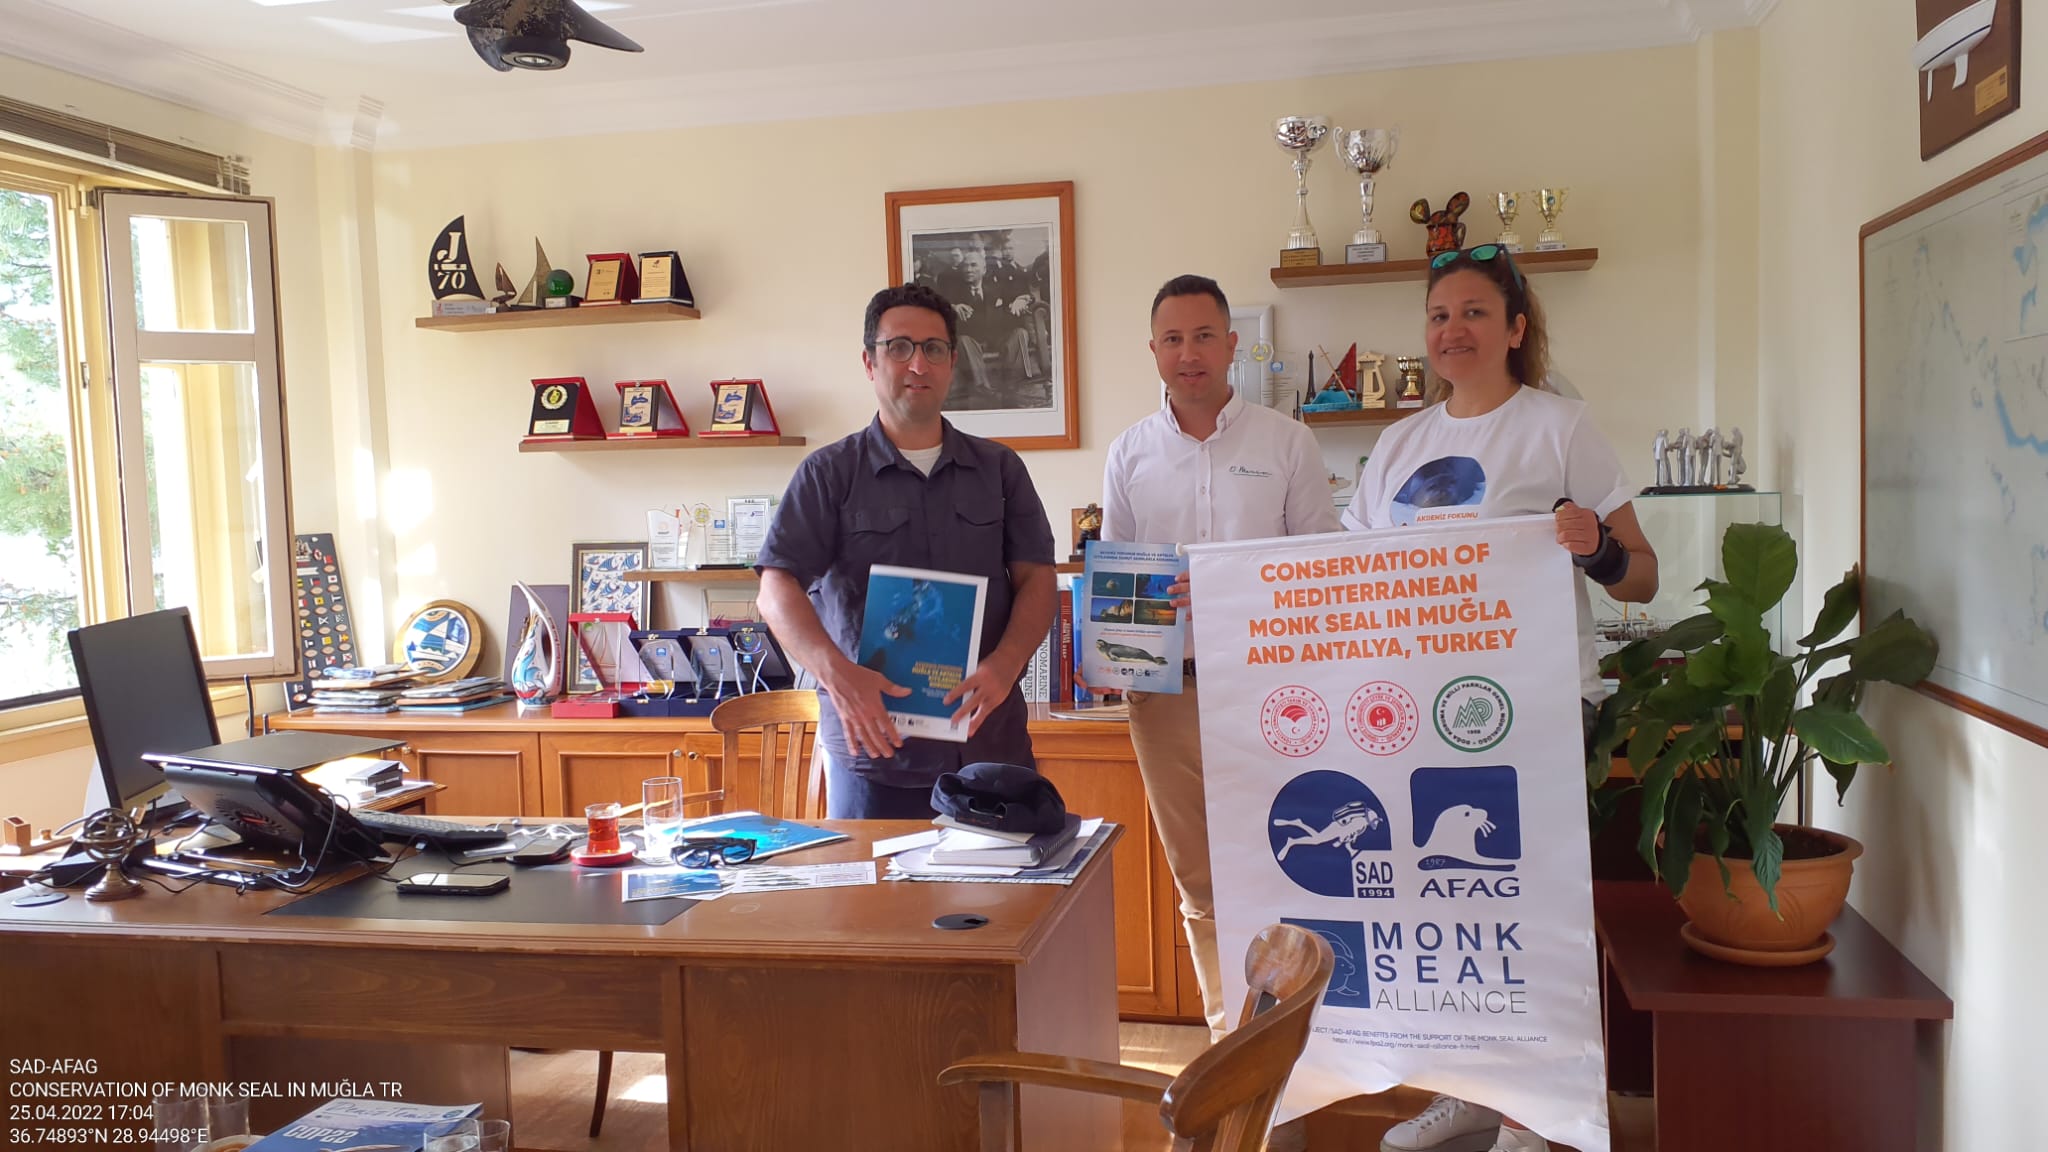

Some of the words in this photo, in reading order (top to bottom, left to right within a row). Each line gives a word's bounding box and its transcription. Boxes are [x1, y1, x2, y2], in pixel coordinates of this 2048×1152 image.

[437, 231, 462, 263] J
[437, 271, 466, 290] 70
[1447, 511, 1479, 520] FOKUNU
[1260, 546, 1448, 583] CONSERVATION
[1454, 543, 1490, 565] OF
[1273, 573, 1478, 609] MEDITERRANEAN
[1249, 615, 1321, 638] MONK
[1325, 611, 1382, 633] SEAL
[1386, 607, 1411, 628] IN
[1417, 597, 1512, 626] MUĞLA
[1247, 645, 1295, 665] AND
[1300, 637, 1411, 662] ANTALYA,
[1416, 628, 1518, 655] TURKEY
[1356, 861, 1393, 884] SAD
[1360, 888, 1392, 898] 1994
[1420, 877, 1520, 898] AFAG
[1372, 922, 1523, 951] MONK
[1374, 954, 1525, 985] SEAL
[1375, 988, 1528, 1014] ALLIANCE
[1362, 1030, 1389, 1038] BENEFITS
[1390, 1032, 1408, 1040] FROM
[1516, 1035, 1548, 1043] ALLIANCE
[283, 1124, 360, 1145] COP22
